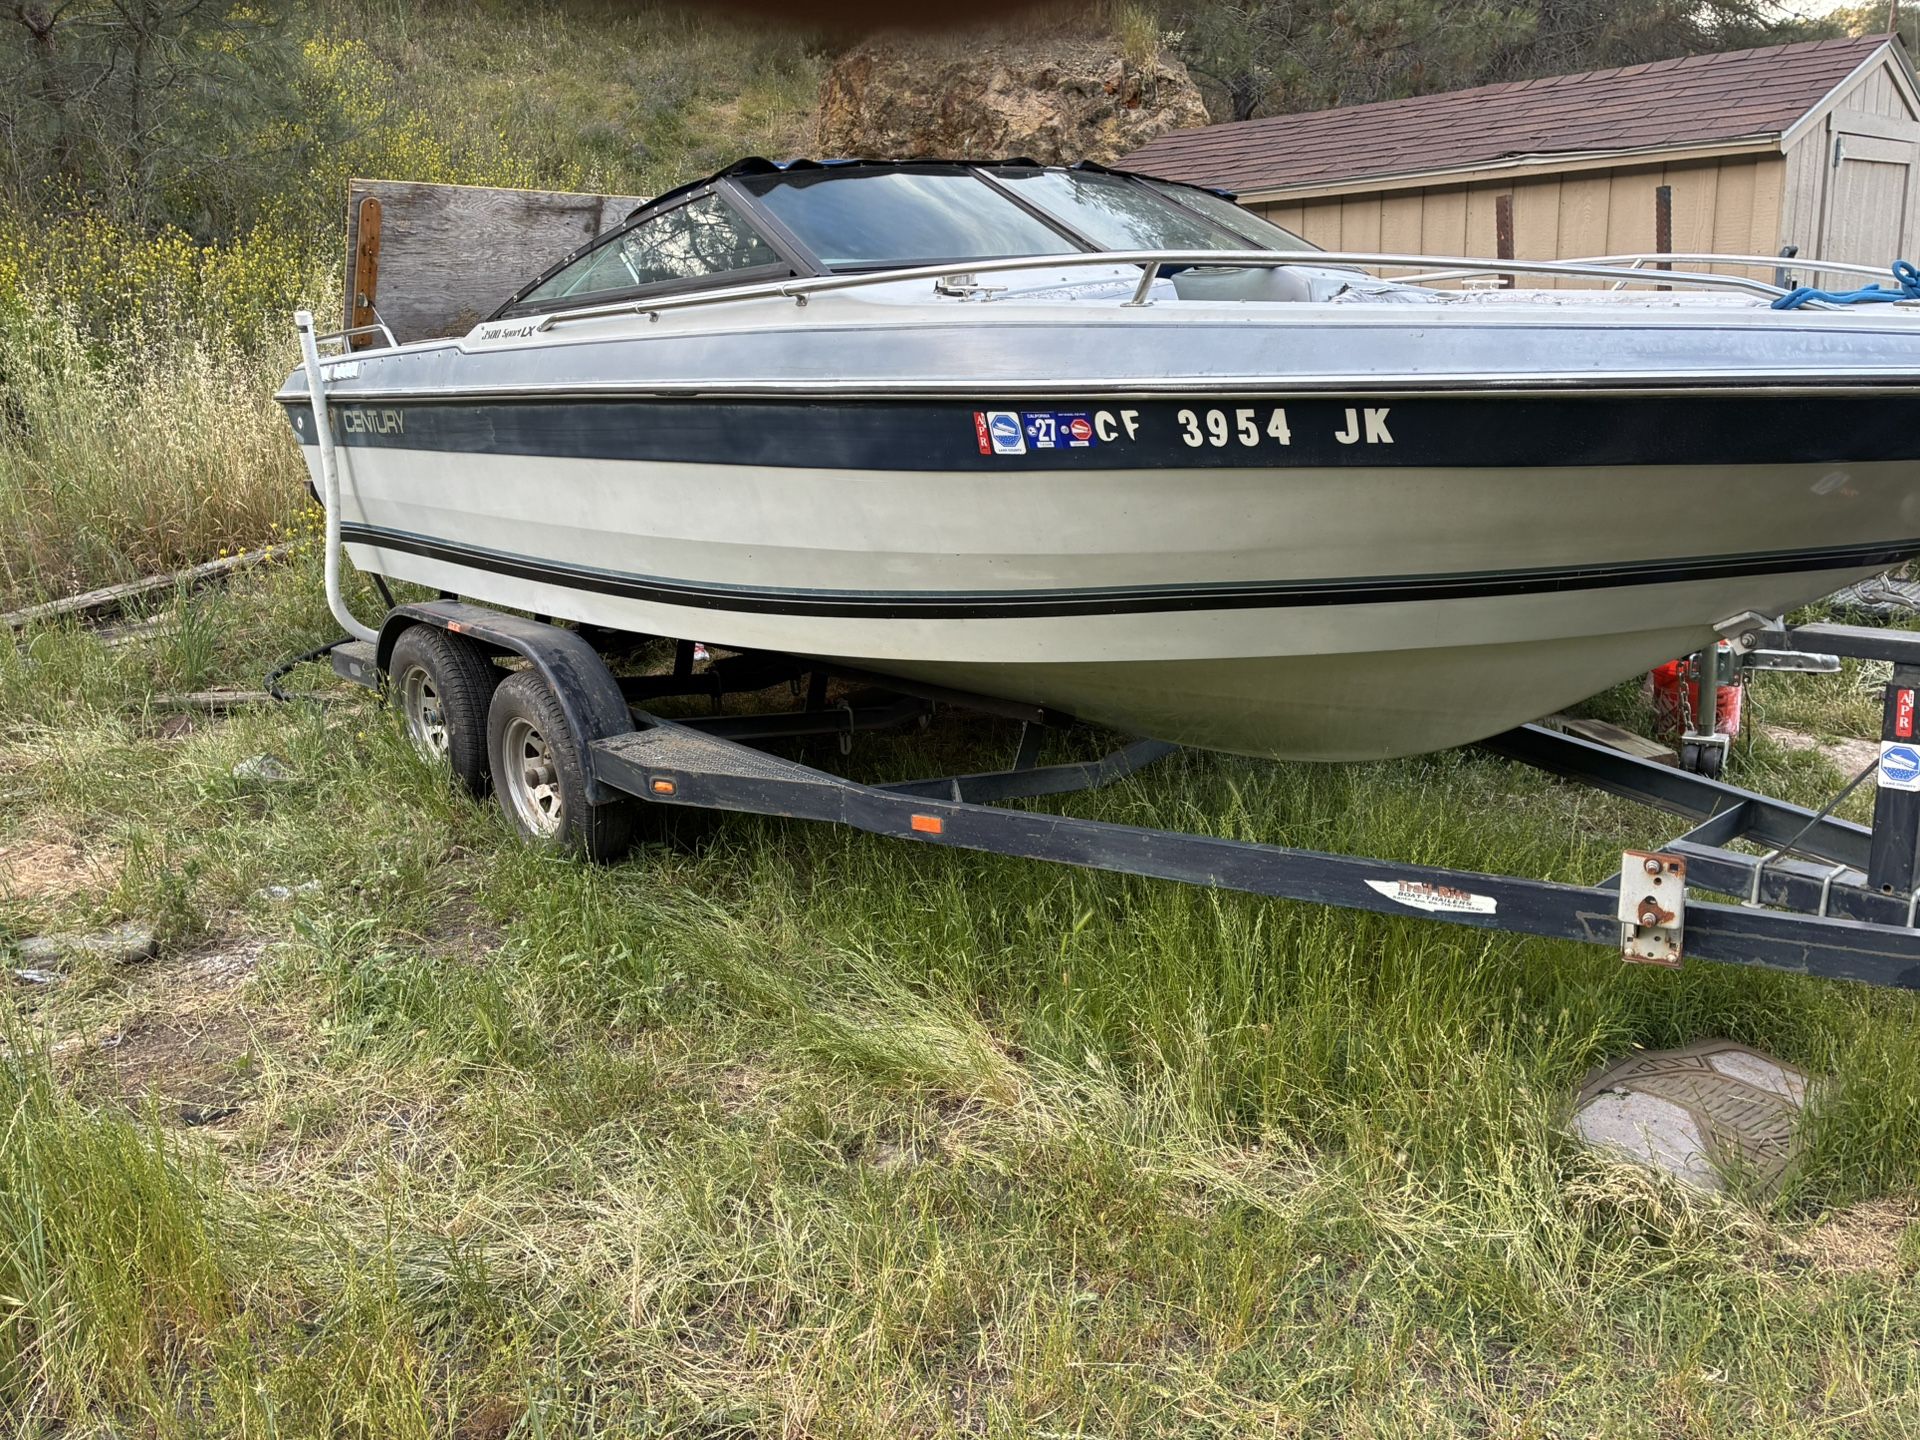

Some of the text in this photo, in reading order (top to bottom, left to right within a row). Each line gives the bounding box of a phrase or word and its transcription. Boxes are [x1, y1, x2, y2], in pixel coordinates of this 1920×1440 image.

[520, 326, 536, 337] LX
[343, 410, 404, 434] CENTURY
[1035, 419, 1056, 441] 27
[1094, 407, 1395, 448] CF 3954 JK
[1899, 693, 1910, 728] APR
